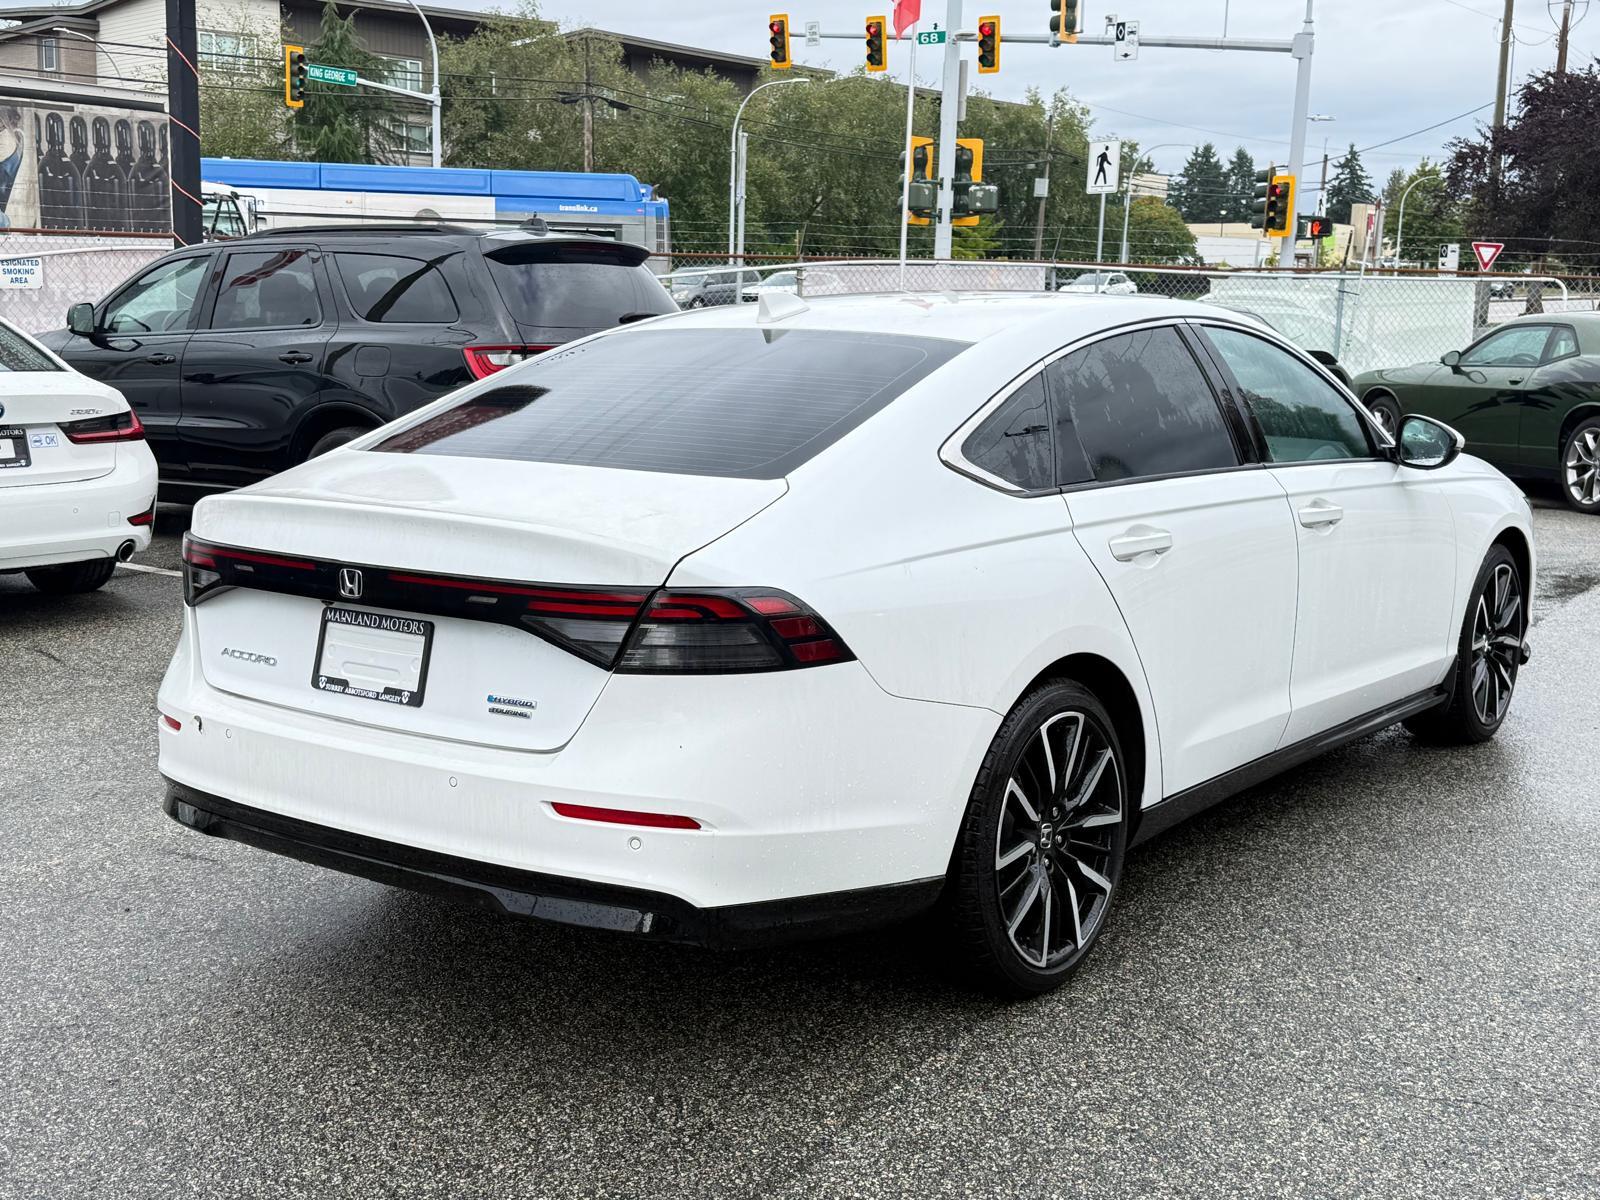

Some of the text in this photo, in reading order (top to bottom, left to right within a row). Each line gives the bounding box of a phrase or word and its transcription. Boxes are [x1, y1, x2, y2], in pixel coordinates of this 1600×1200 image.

[920, 33, 939, 44] 68
[310, 67, 323, 78] KING
[324, 69, 346, 82] GEORGE
[560, 204, 598, 212] translink.ca
[0, 259, 40, 267] ESIGNATED
[45, 435, 56, 445] OK
[325, 608, 425, 634] MAINLAND MOTORS
[220, 647, 278, 667] ACCORD
[325, 683, 401, 703] SURREY ABBOTSFORD LANGLEY
